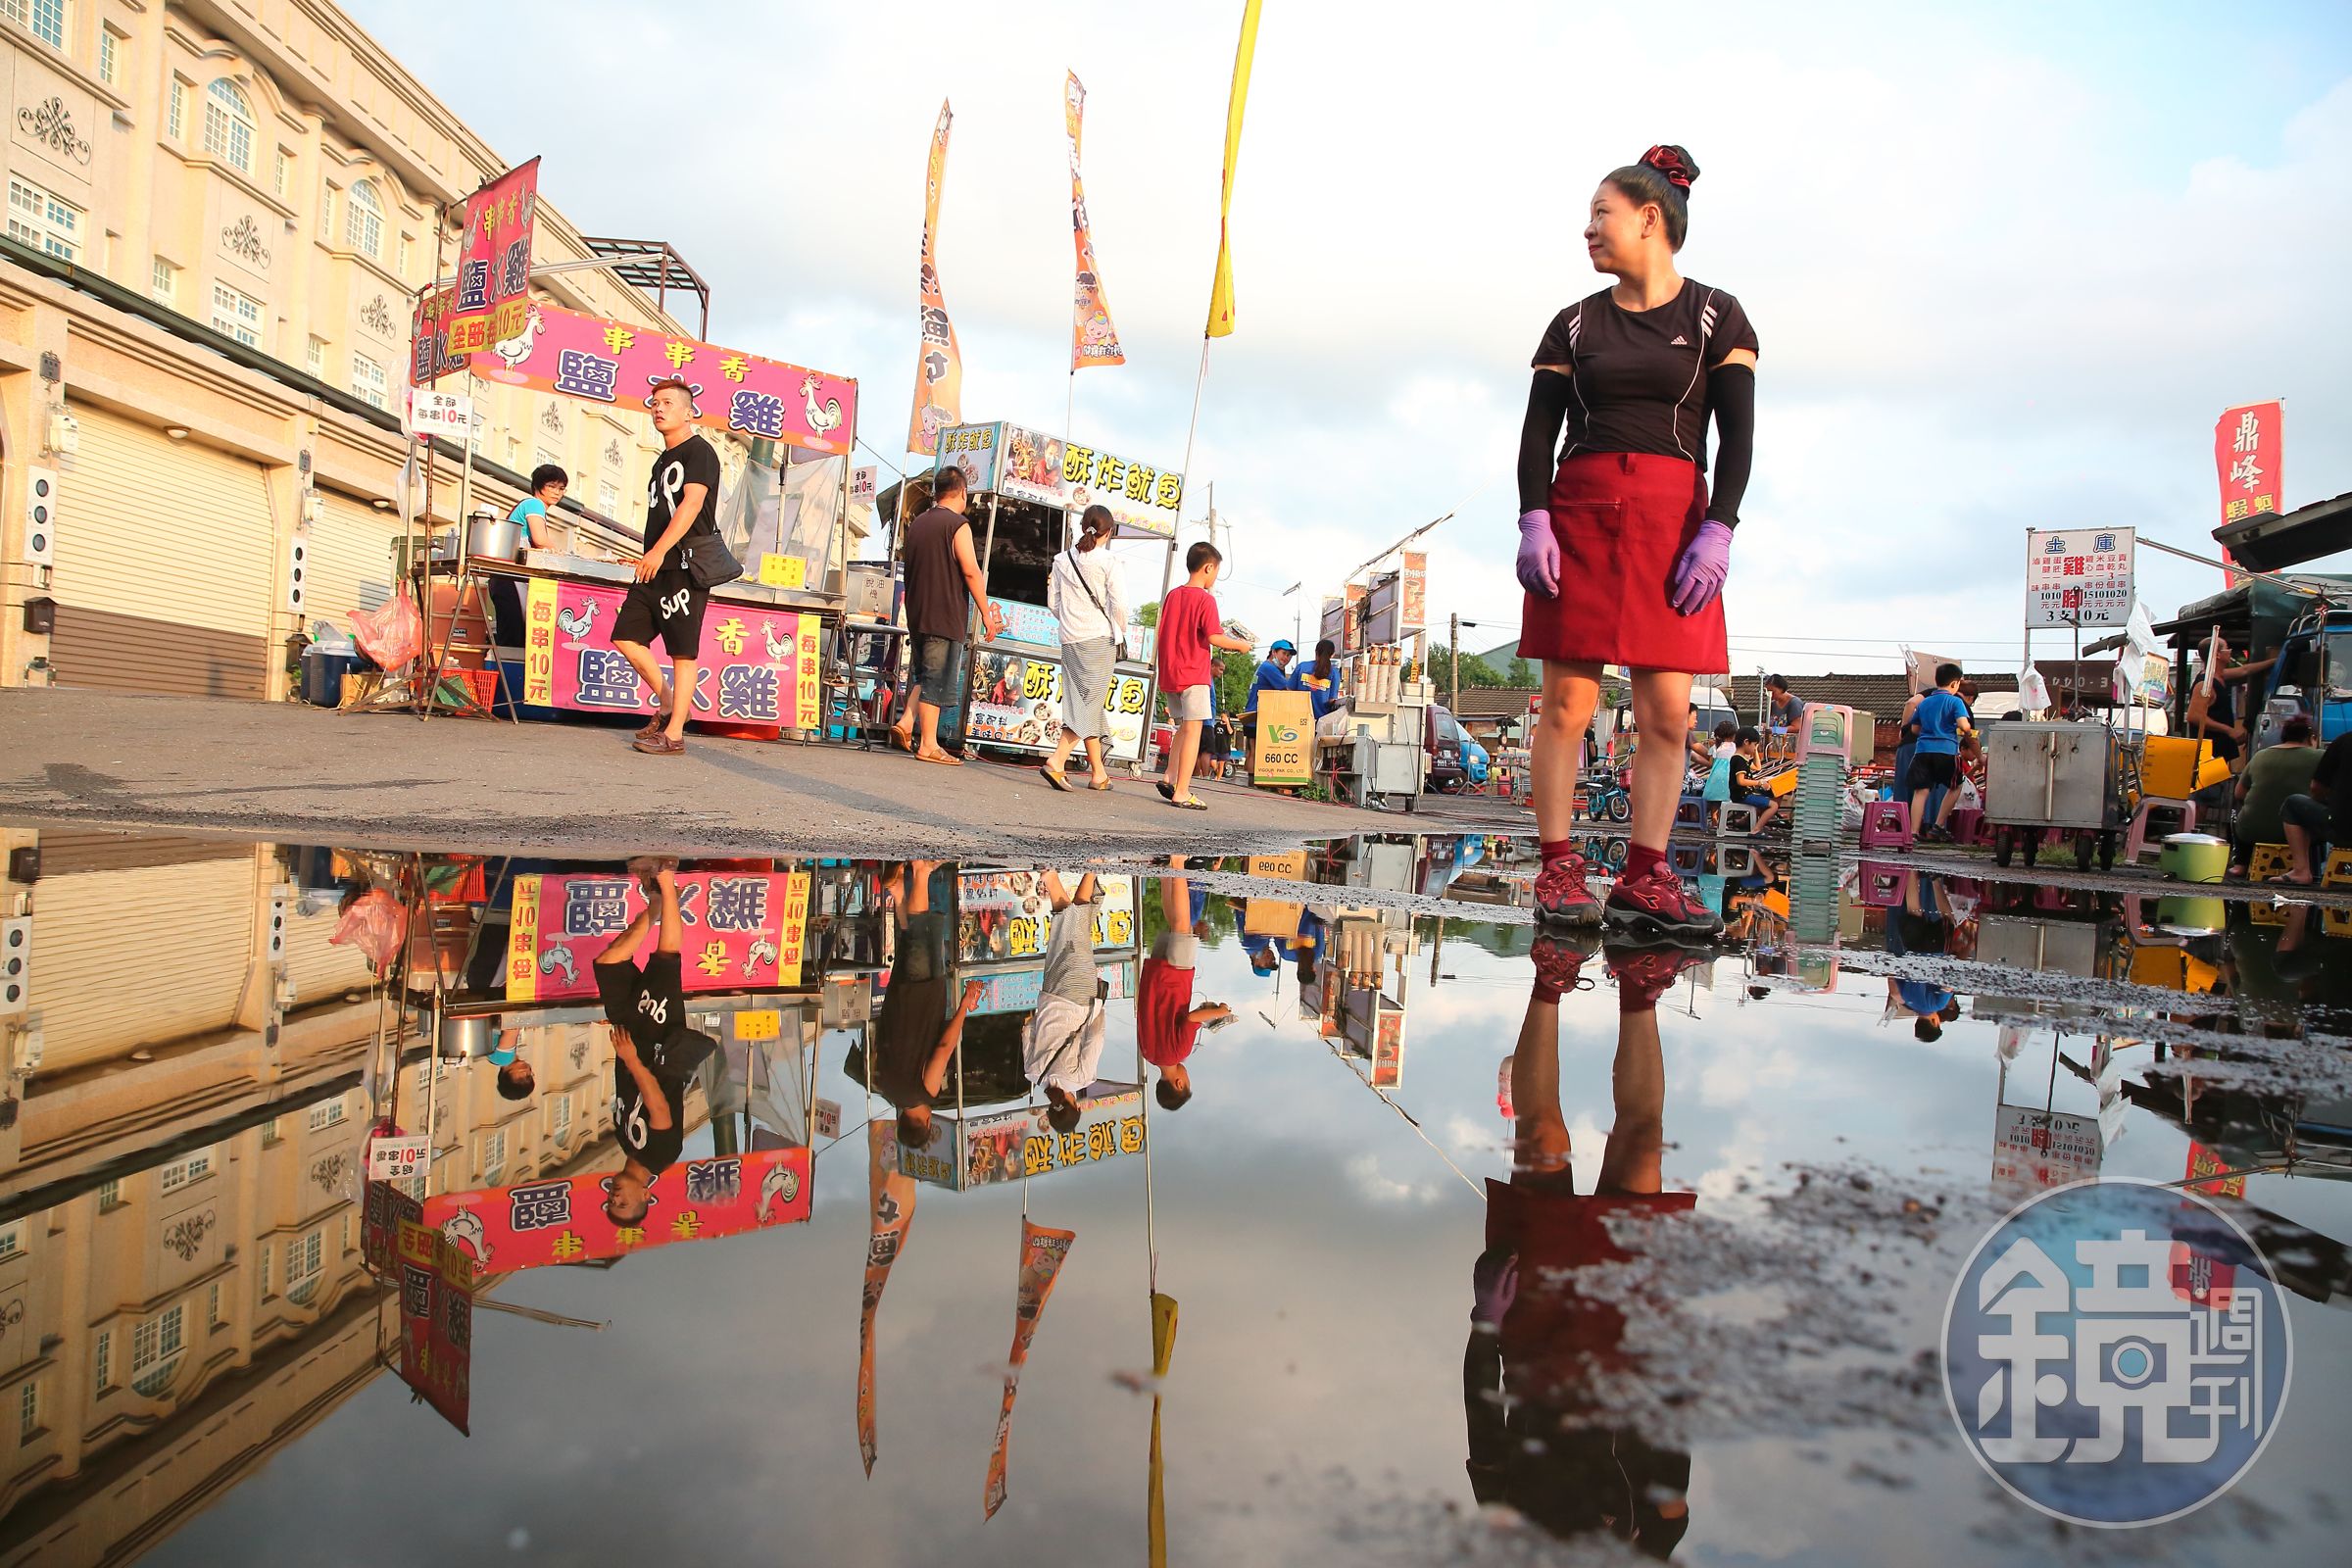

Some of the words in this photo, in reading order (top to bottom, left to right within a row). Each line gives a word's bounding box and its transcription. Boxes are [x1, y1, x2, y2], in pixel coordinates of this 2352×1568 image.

[603, 326, 753, 384] 串串香
[417, 408, 467, 424] 每串10元
[433, 395, 456, 408] 全部
[946, 428, 993, 454] 酥炸魷魚
[2230, 411, 2264, 493] 鼎峰
[1062, 443, 1182, 511] 酥炸魷魚
[2045, 533, 2116, 554] 土庫
[660, 588, 690, 620] Sup
[529, 600, 552, 702] 每串10元
[799, 633, 818, 727] 每串10元
[1265, 754, 1281, 763] 660
[1284, 754, 1298, 763] CC
